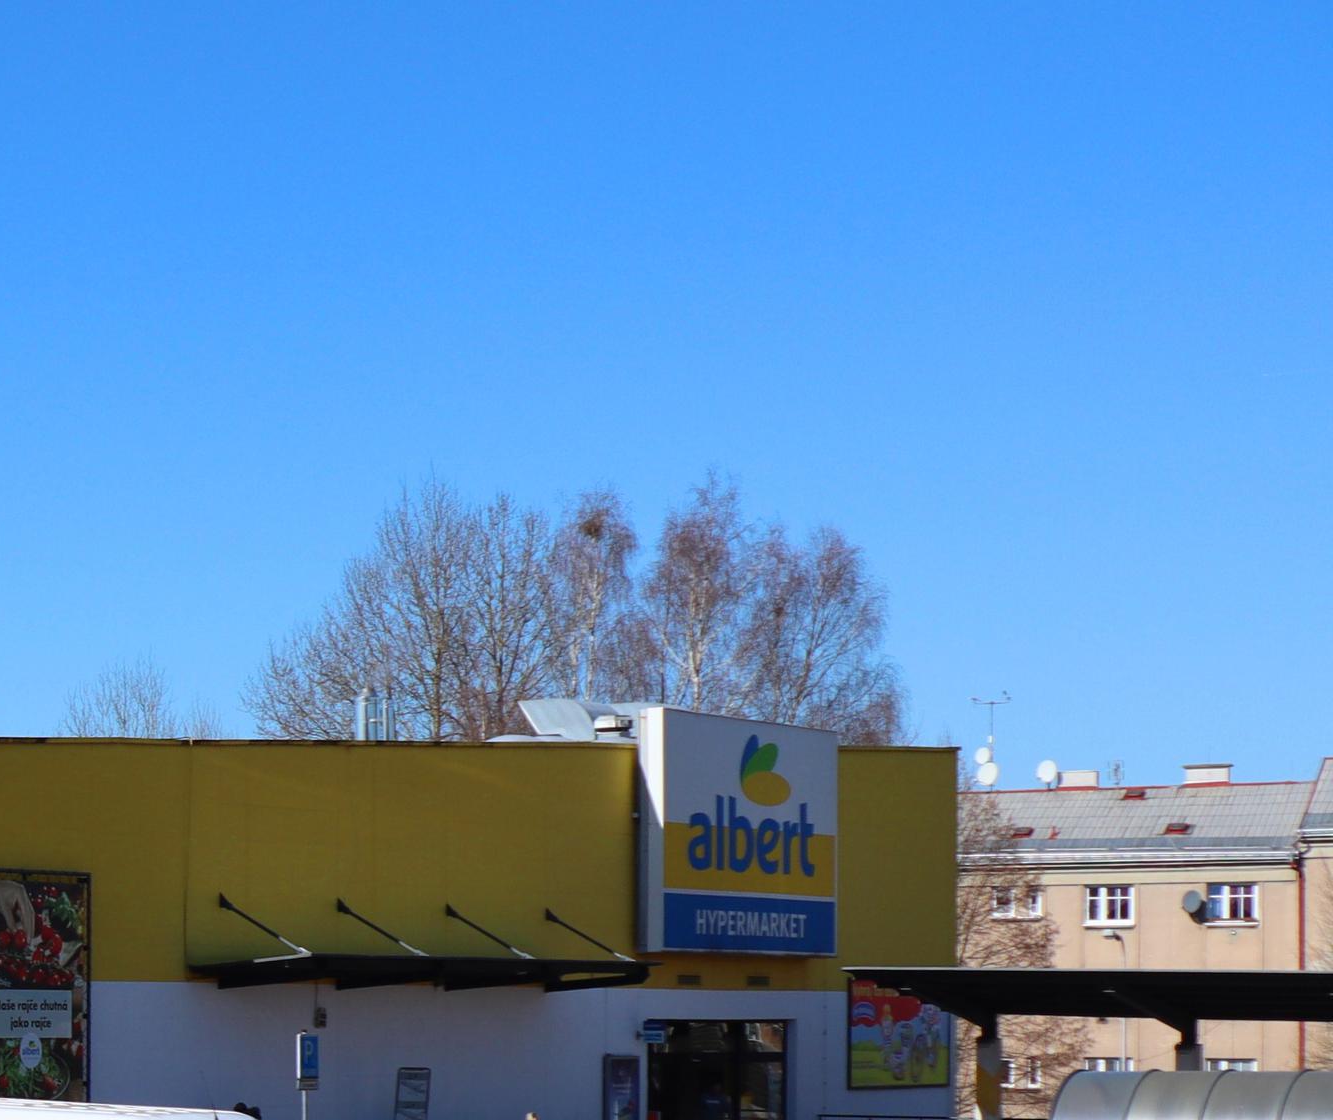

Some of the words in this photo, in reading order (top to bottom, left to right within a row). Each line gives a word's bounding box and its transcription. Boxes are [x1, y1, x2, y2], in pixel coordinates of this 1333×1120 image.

[688, 795, 815, 877] albert
[696, 909, 807, 938] HYPERMARKET
[17, 999, 39, 1013] rajče
[40, 999, 68, 1010] chutná
[10, 1016, 29, 1031] jako
[31, 1016, 52, 1031] rajče
